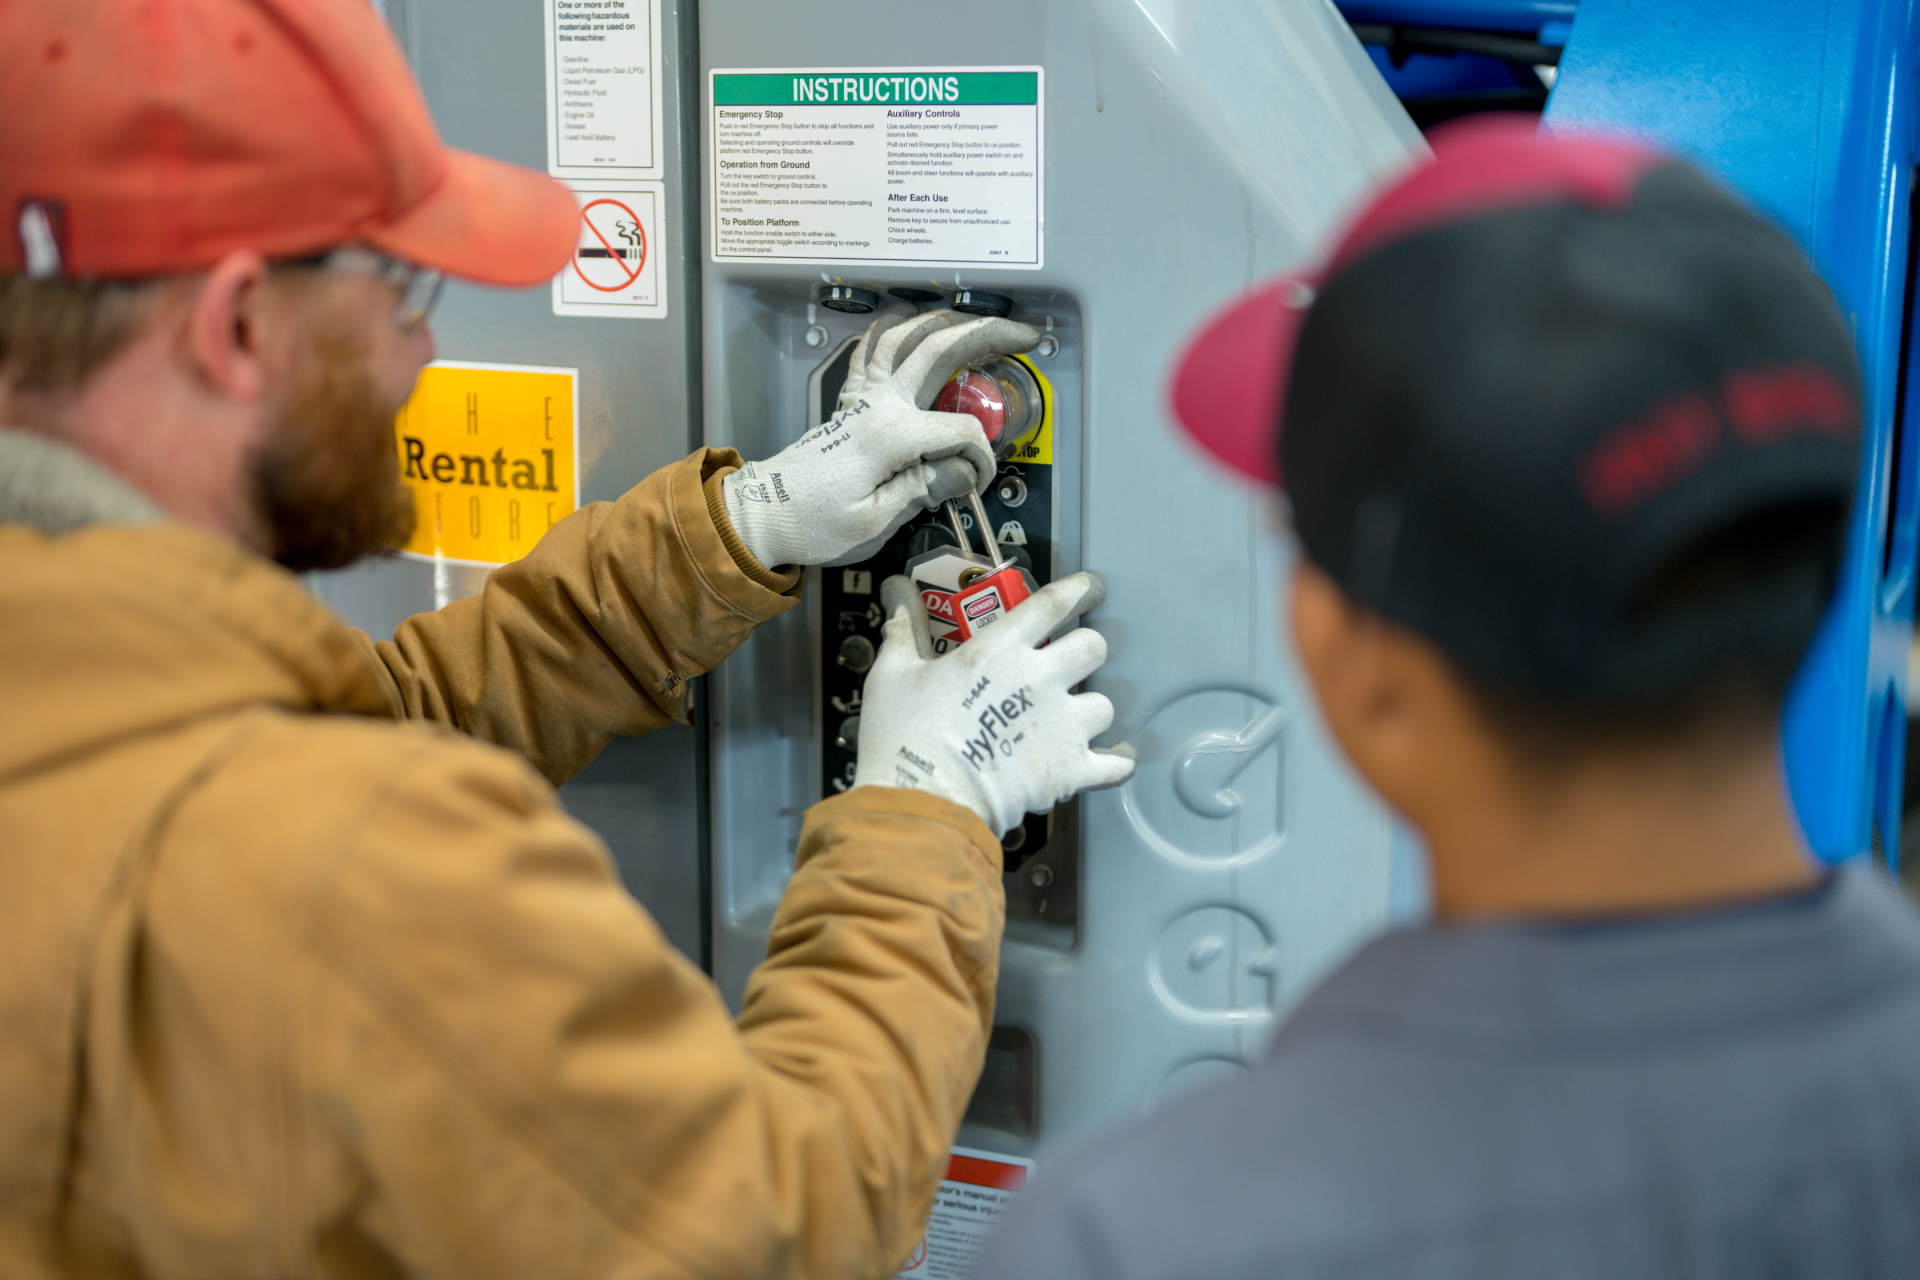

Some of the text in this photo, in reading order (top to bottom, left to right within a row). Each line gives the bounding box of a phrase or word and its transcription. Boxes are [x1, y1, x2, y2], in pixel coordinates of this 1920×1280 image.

[558, 12, 591, 21] following
[564, 67, 581, 75] Liquid
[564, 89, 590, 97] Hydraulic
[793, 77, 959, 102] INSTRUCTIONS
[565, 111, 584, 120] Engine
[720, 110, 783, 120] Emergency Stop
[887, 110, 922, 119] Auxiliary
[596, 134, 615, 142] Battery
[887, 151, 928, 159] Simultaneously
[720, 160, 758, 169] Operation
[933, 194, 948, 202] Use
[733, 218, 764, 226] Position
[821, 432, 851, 453] 11-644
[403, 436, 558, 492] Rental
[772, 472, 790, 503] Ansell
[969, 598, 995, 614] DANGER
[962, 676, 990, 709] 11-644
[962, 688, 1034, 771] HyFlex
[964, 1190, 997, 1202] manual
[944, 1201, 977, 1211] serious
